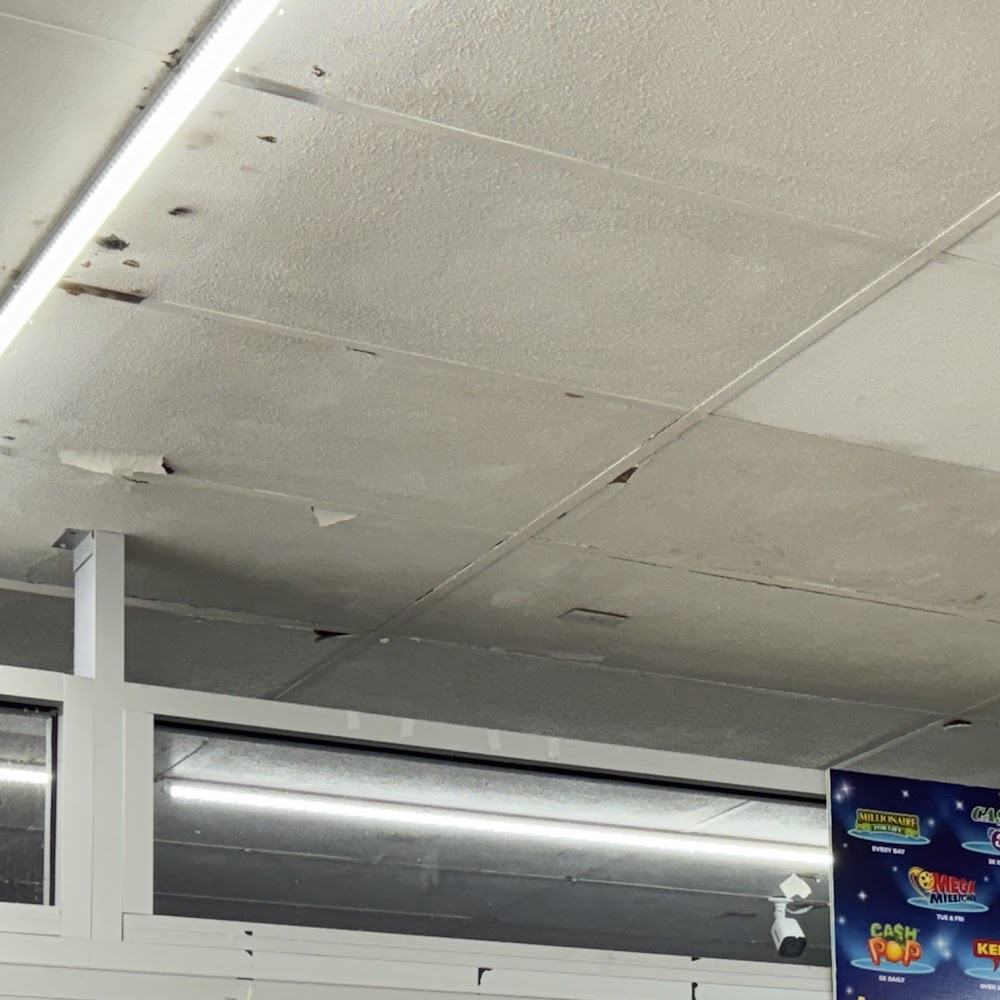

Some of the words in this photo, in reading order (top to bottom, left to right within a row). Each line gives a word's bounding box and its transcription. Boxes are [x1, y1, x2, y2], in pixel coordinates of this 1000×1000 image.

[858, 811, 918, 828] MILLIONAIRE
[932, 871, 976, 895] MEGA
[867, 937, 922, 967] POP
